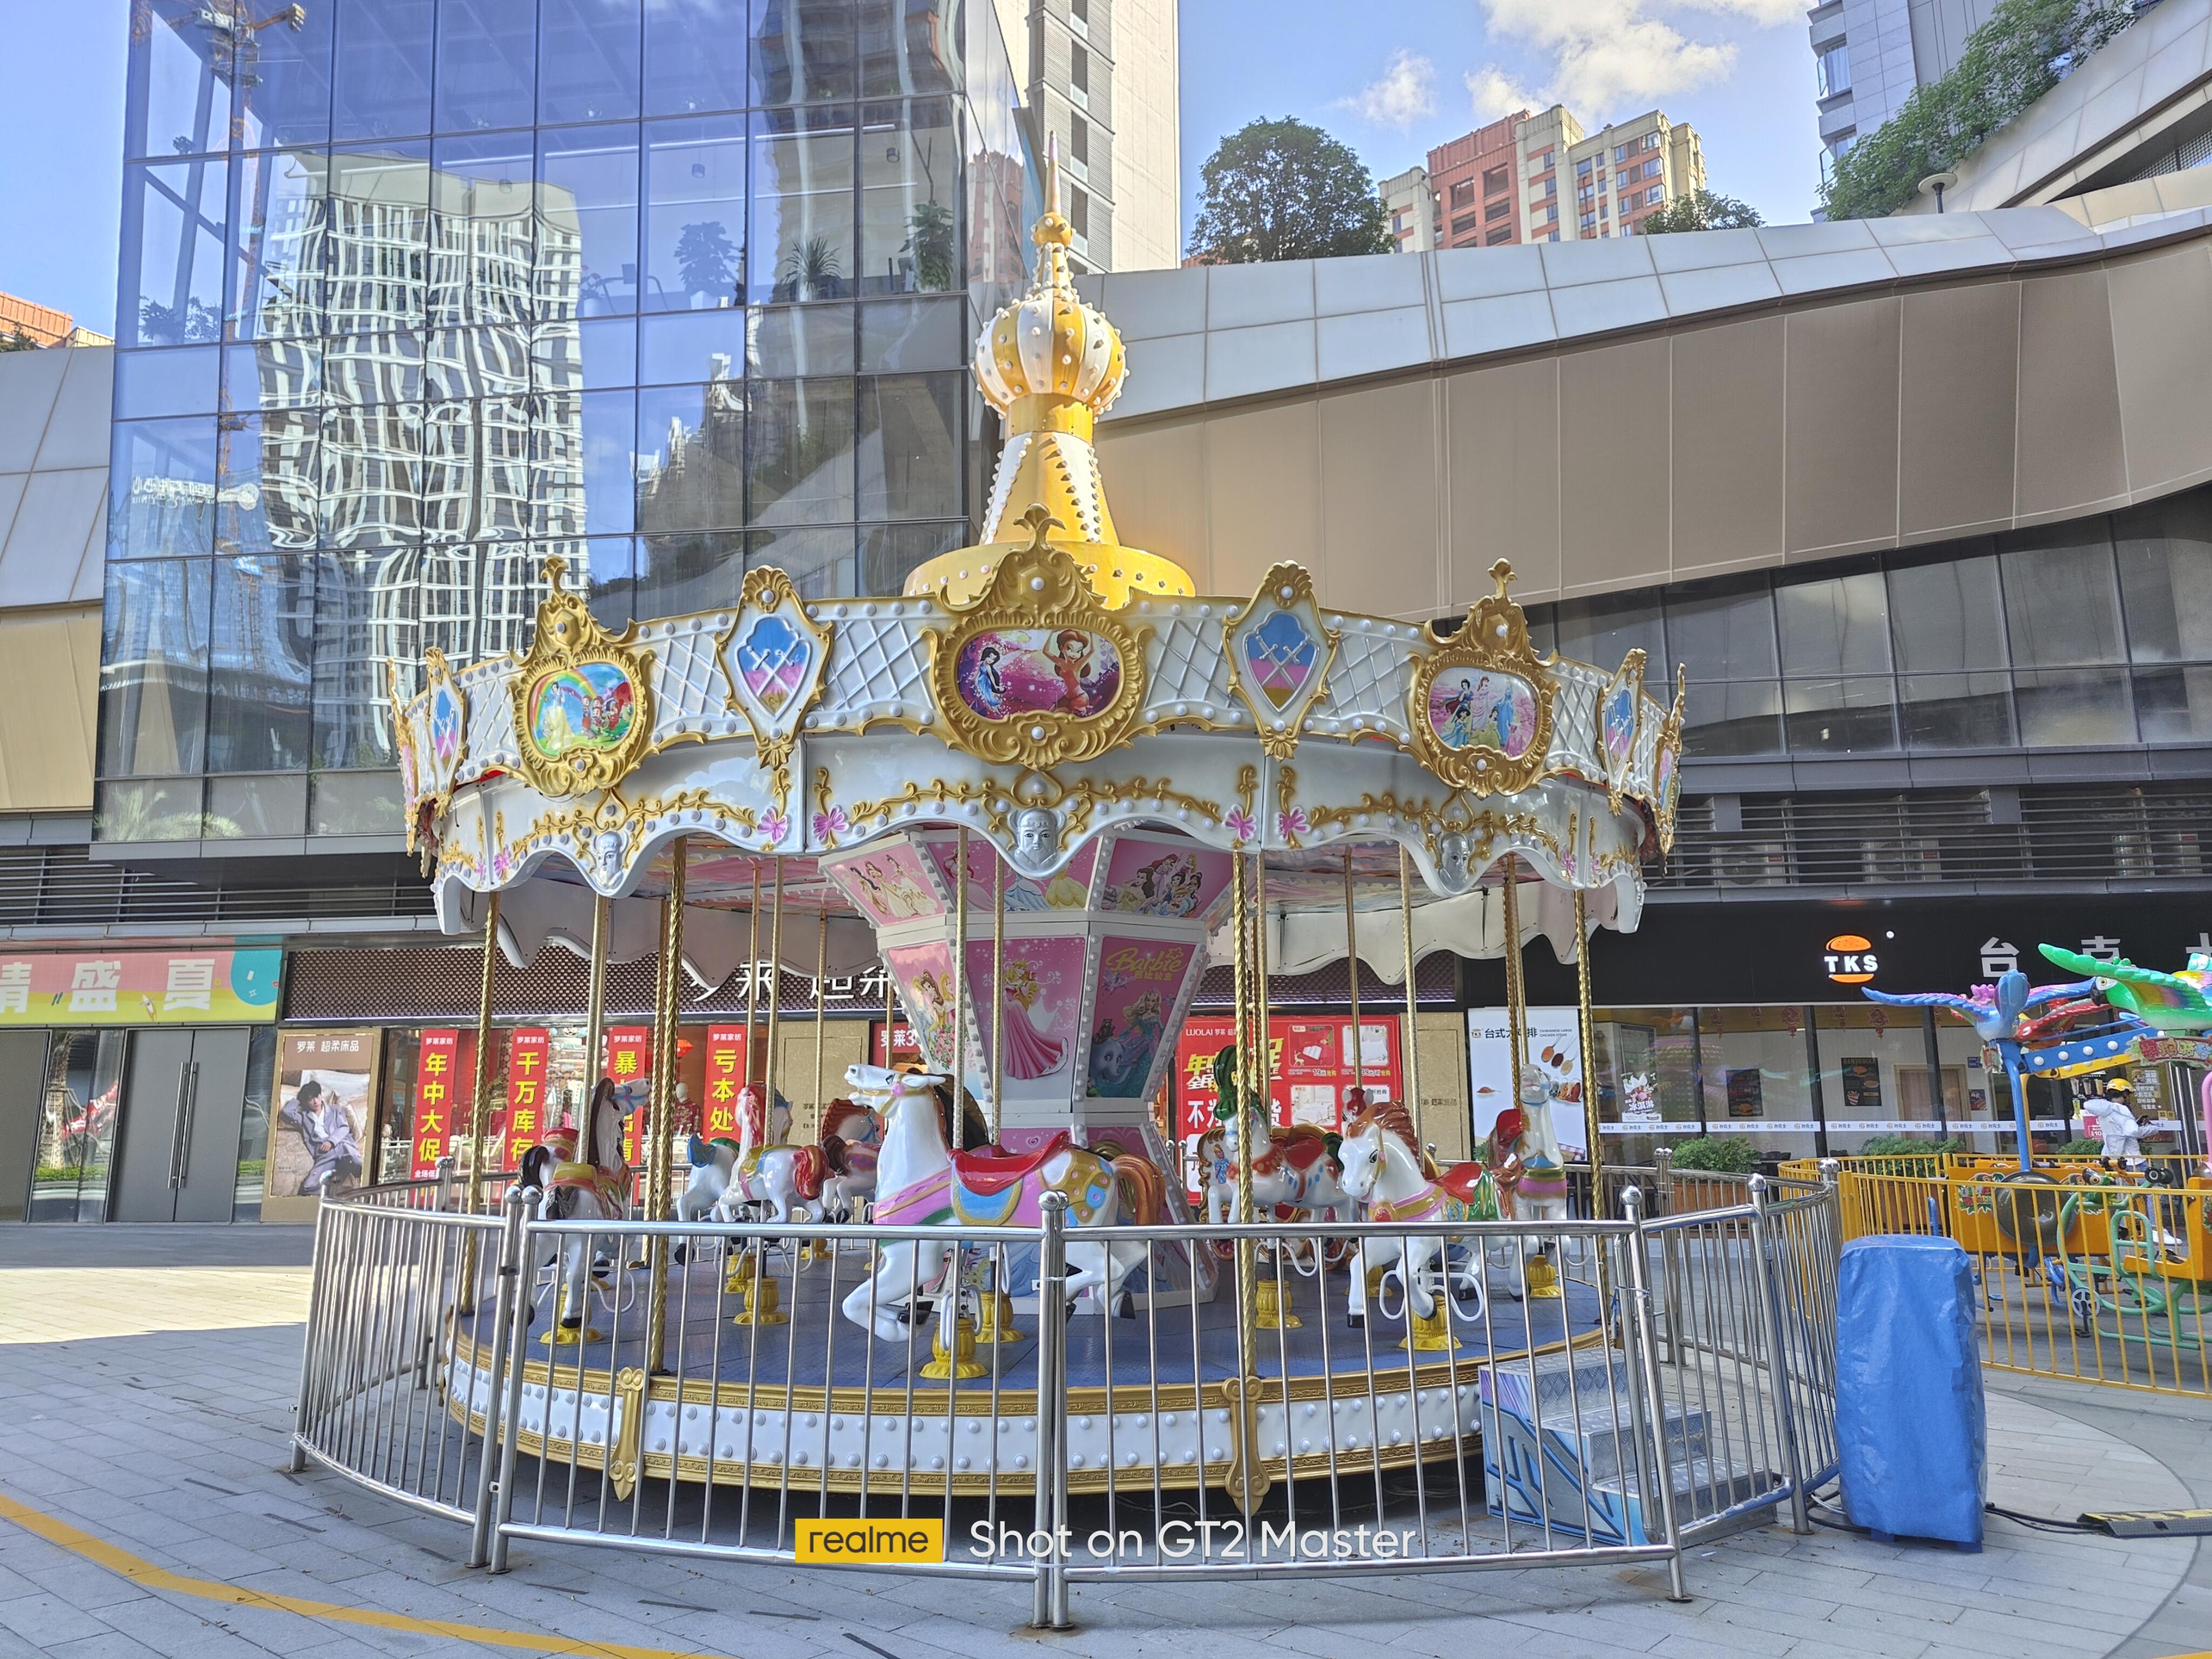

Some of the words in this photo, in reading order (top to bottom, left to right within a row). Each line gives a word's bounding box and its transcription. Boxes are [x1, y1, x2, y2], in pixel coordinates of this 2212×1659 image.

[1106, 947, 1189, 972] Barbie
[1824, 955, 1878, 972] TKS
[713, 1033, 741, 1041] 罗莱家纺
[1485, 1027, 1538, 1038] 台式排
[425, 1037, 453, 1045] 罗莱家纺
[516, 1036, 545, 1044] 罗莱家纺
[613, 1035, 642, 1043] 罗莱家纺
[297, 1041, 315, 1053] 罗莱
[321, 1040, 359, 1052] 超柔床品
[710, 1049, 737, 1141] 亏本处
[419, 1052, 448, 1162] 年中大促
[511, 1051, 540, 1161] 千万库存
[1628, 1100, 1655, 1111] 冰淇淋
